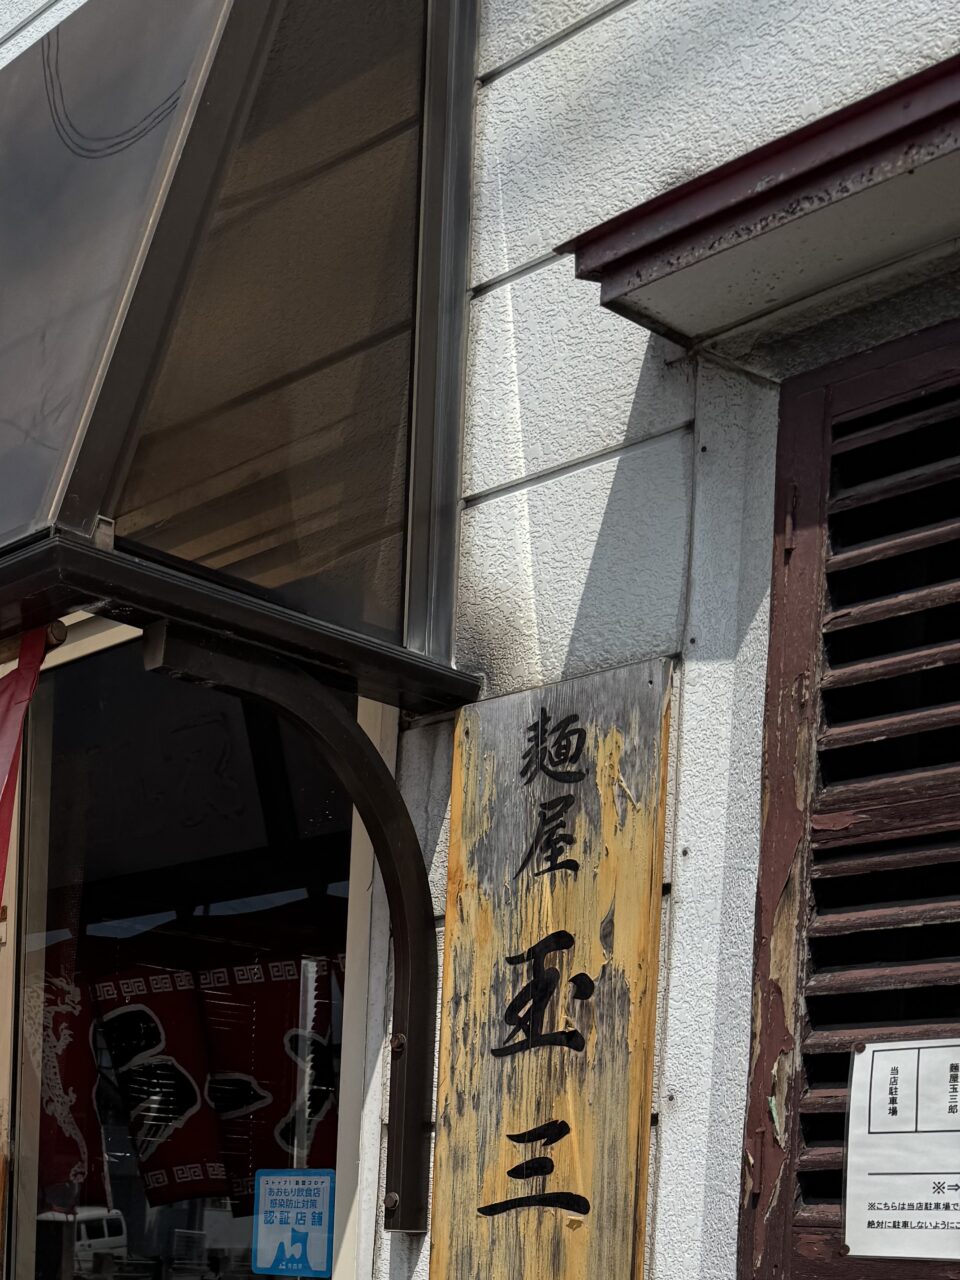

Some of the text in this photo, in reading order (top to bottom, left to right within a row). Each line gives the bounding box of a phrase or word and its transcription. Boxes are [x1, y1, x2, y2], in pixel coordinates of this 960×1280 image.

[887, 1066, 899, 1117] 当店駐車場
